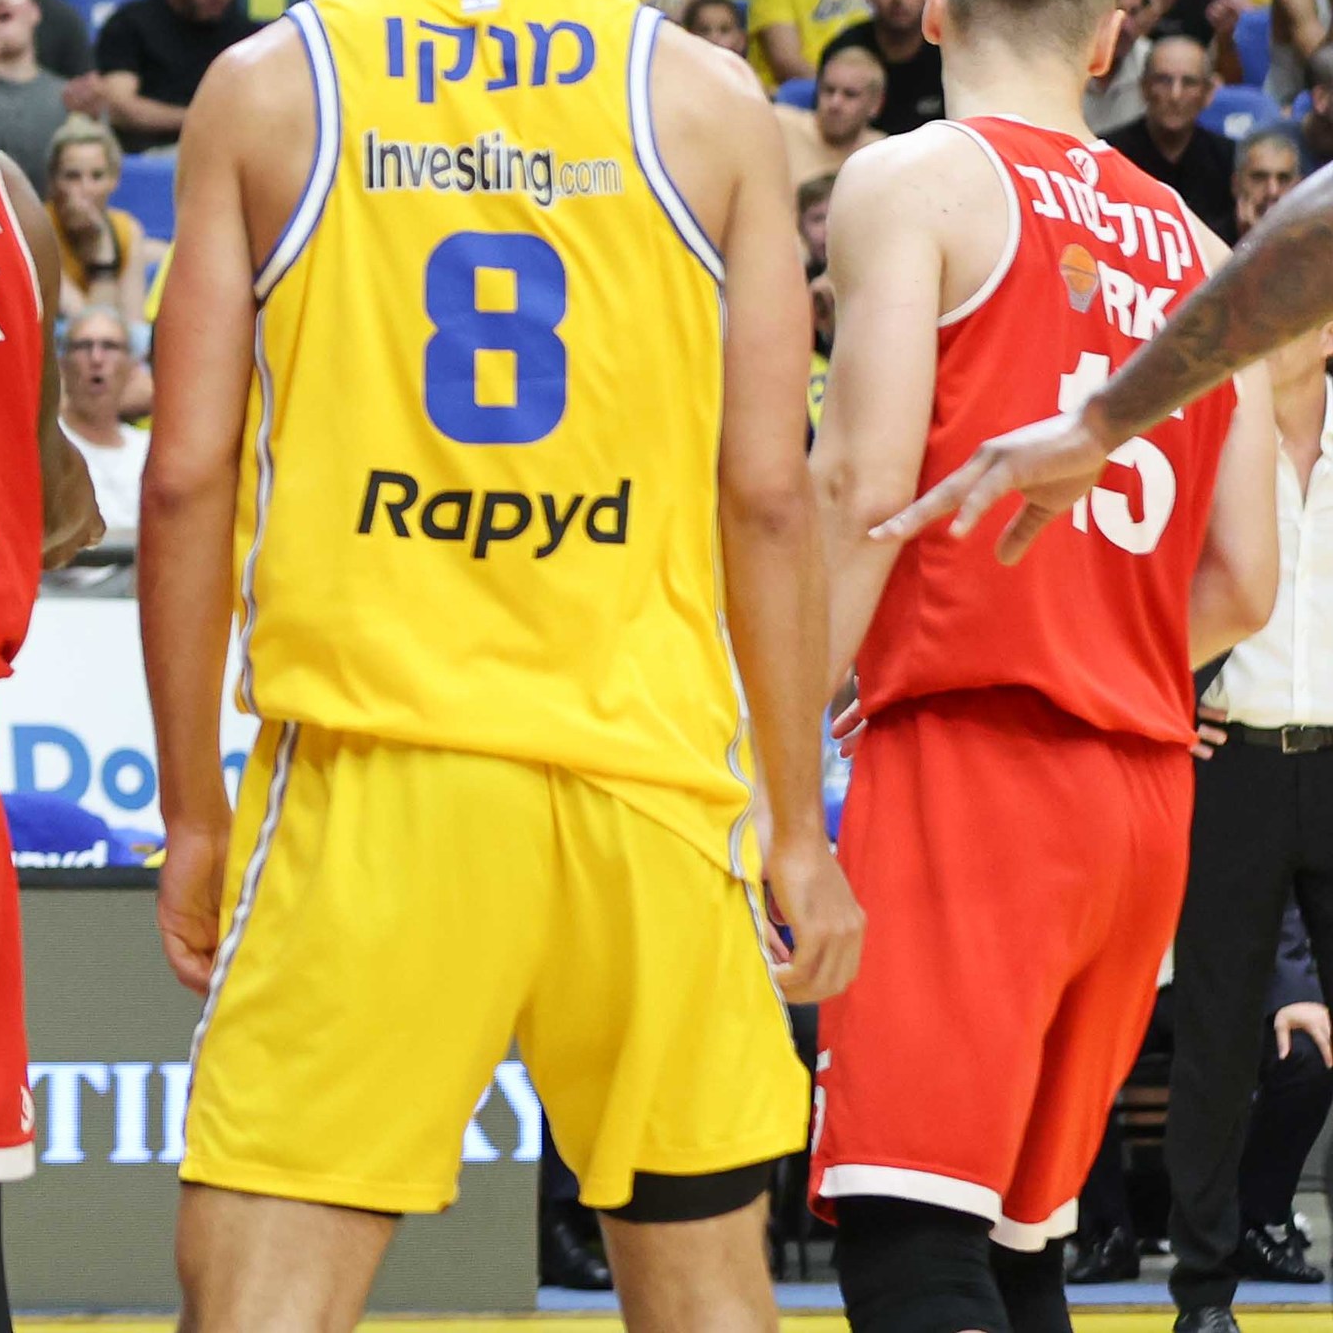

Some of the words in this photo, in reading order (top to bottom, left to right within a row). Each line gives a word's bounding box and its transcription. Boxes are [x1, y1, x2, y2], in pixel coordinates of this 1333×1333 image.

[385, 16, 596, 103] מנקו
[364, 130, 623, 207] Investing.com
[424, 231, 567, 444] 8
[1096, 259, 1177, 342] RK
[357, 469, 632, 560] Rapyd
